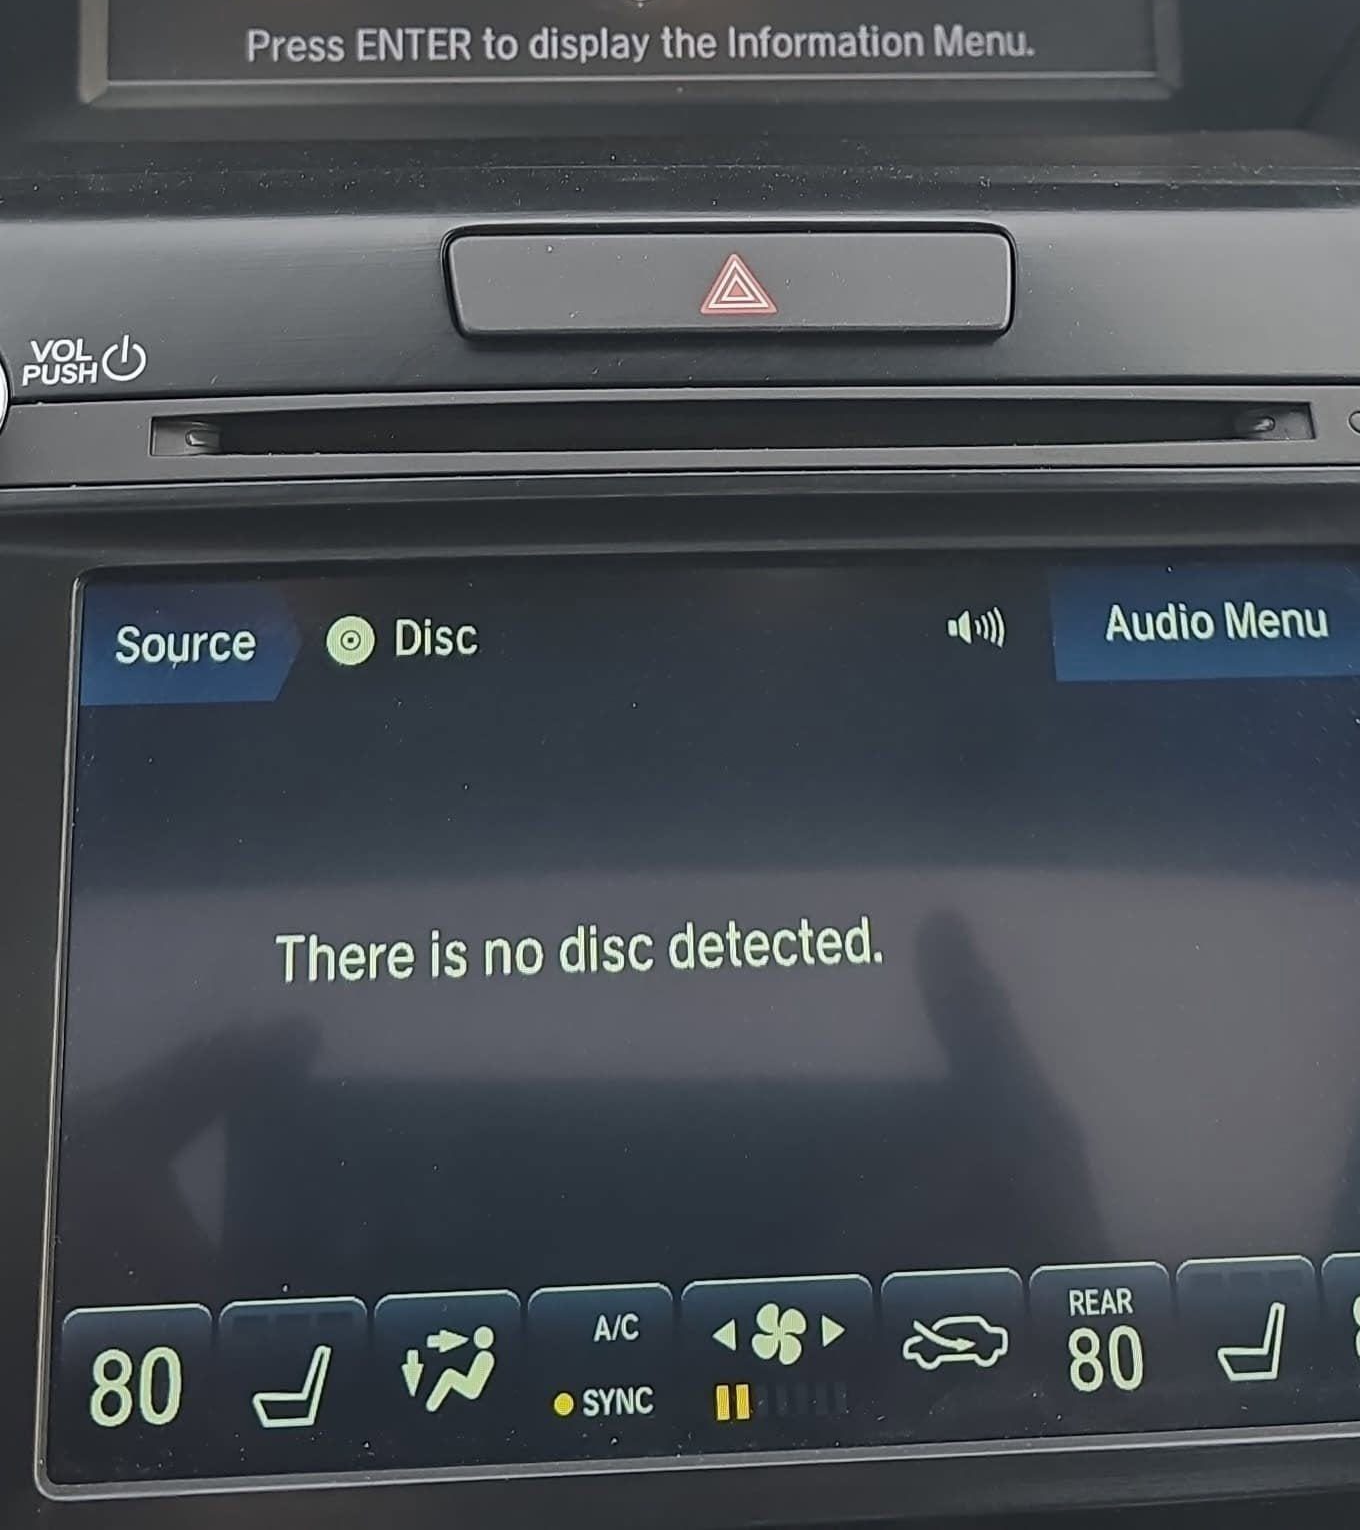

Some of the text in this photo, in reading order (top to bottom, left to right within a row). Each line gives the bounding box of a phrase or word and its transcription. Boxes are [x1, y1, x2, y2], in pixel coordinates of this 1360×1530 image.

[246, 23, 1035, 63] Press ENTER to display the Information Menu.
[30, 338, 93, 363] VOL
[22, 362, 98, 386] PUSH
[395, 618, 478, 657] Disc
[1105, 600, 1330, 642] Audio Menu
[115, 626, 257, 665] Source
[275, 916, 883, 984] There is no disc detected.
[1068, 1287, 1134, 1317] REAR
[592, 1314, 640, 1343] A/C
[1067, 1325, 1145, 1393] 80
[89, 1346, 182, 1428] 80
[581, 1385, 655, 1417] SYNC
